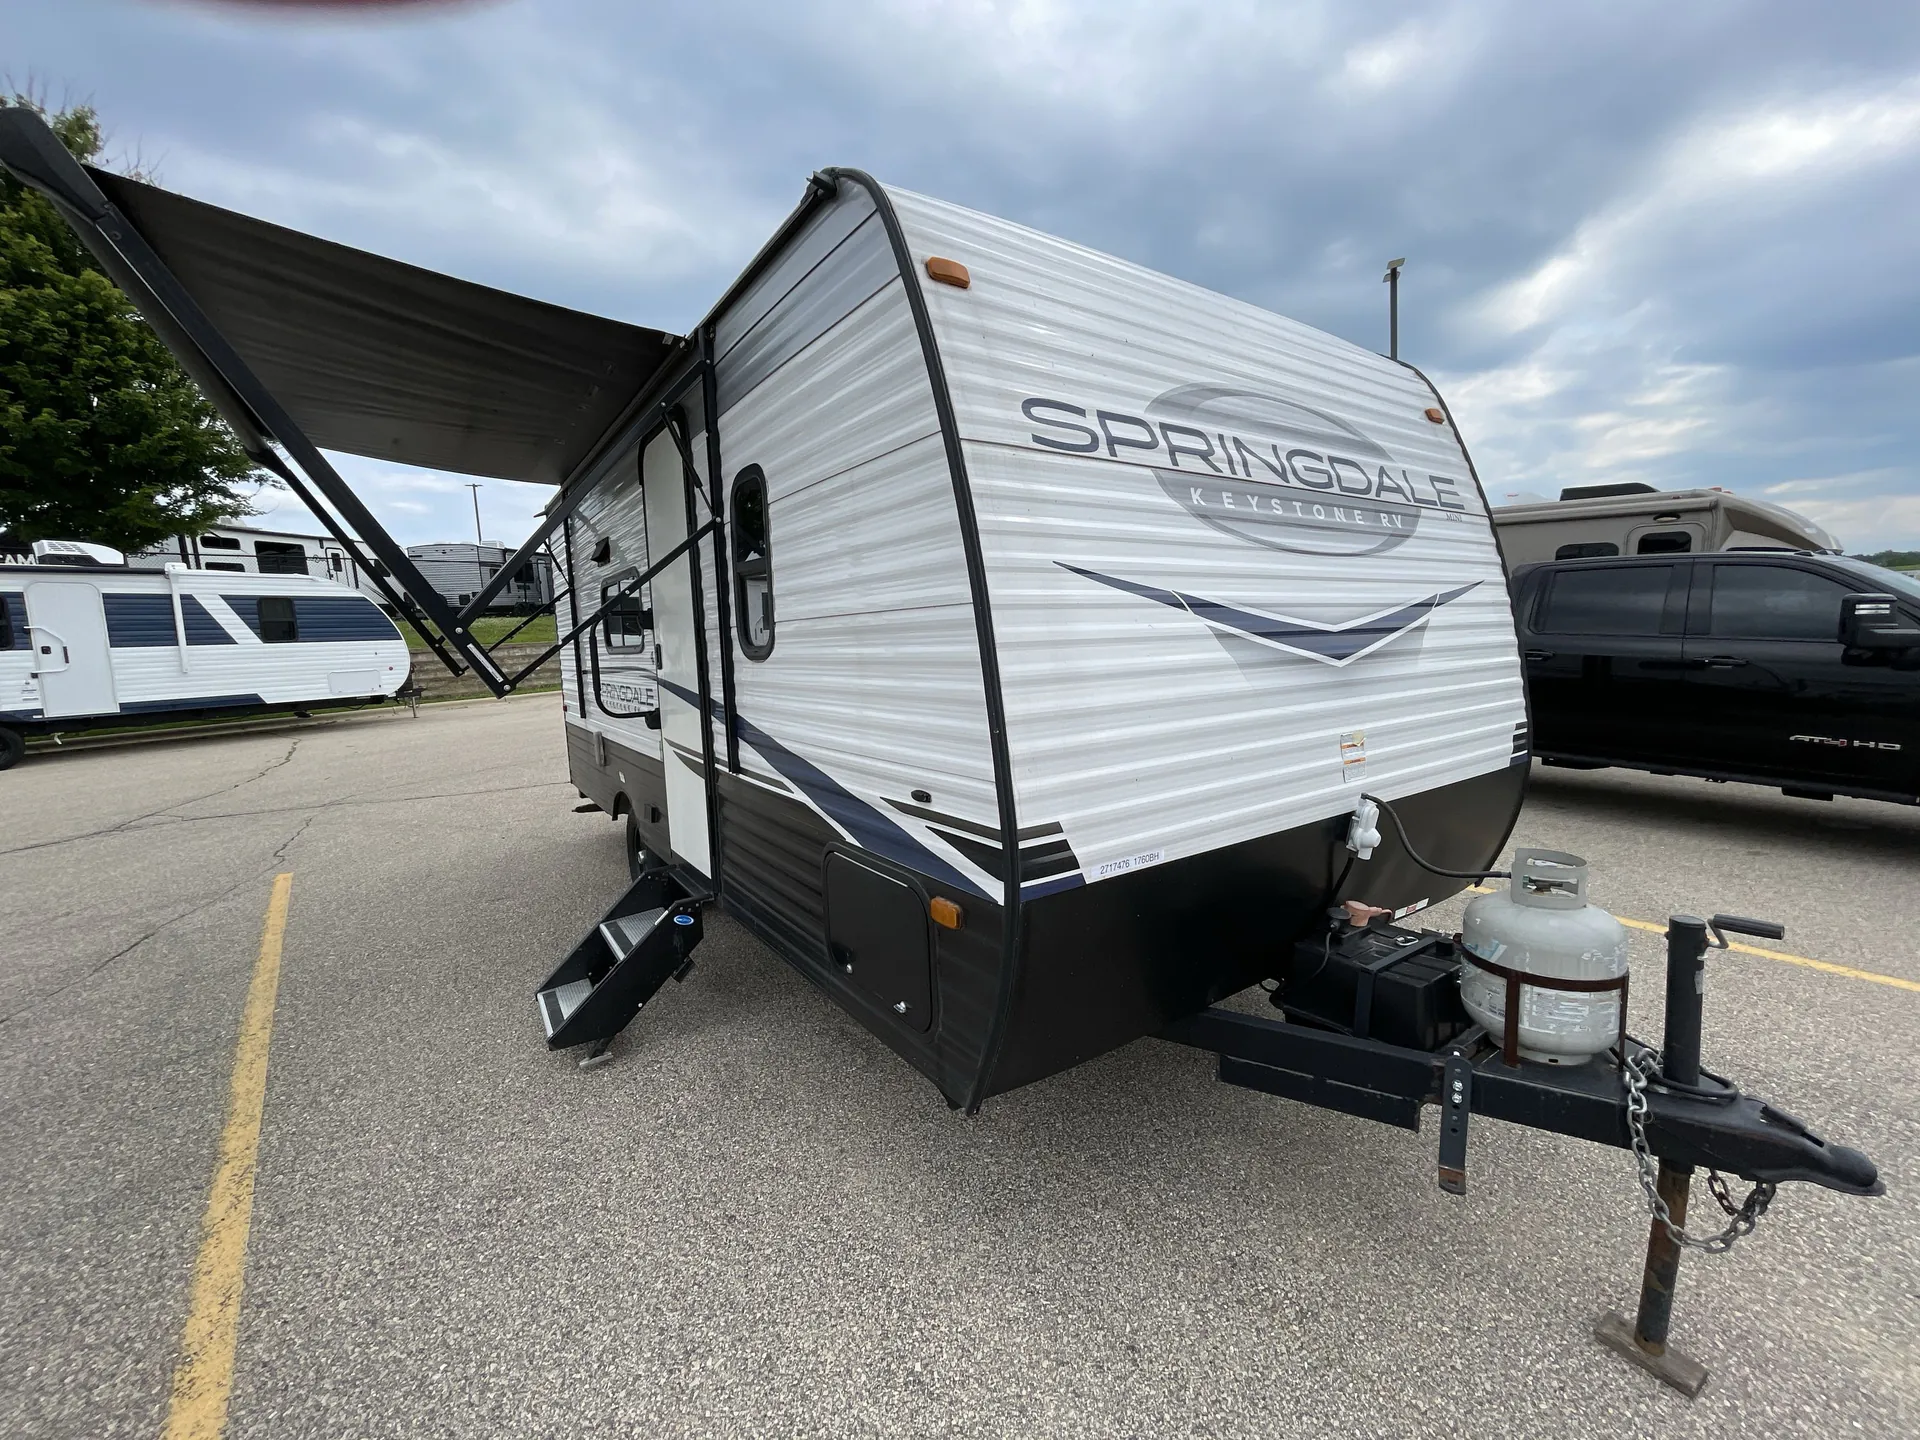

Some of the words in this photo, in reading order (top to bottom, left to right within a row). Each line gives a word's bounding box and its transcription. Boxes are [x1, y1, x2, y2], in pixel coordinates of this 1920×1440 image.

[1021, 397, 1465, 510] SPRINGDALE
[1190, 487, 1365, 525] KEYSTONE
[1380, 512, 1402, 528] RV
[0, 553, 36, 565] AM
[601, 683, 653, 706] PRINGDALE
[1853, 740, 1901, 750] HD
[1100, 859, 1130, 875] 2717476
[1134, 852, 1160, 865] 1760BH
